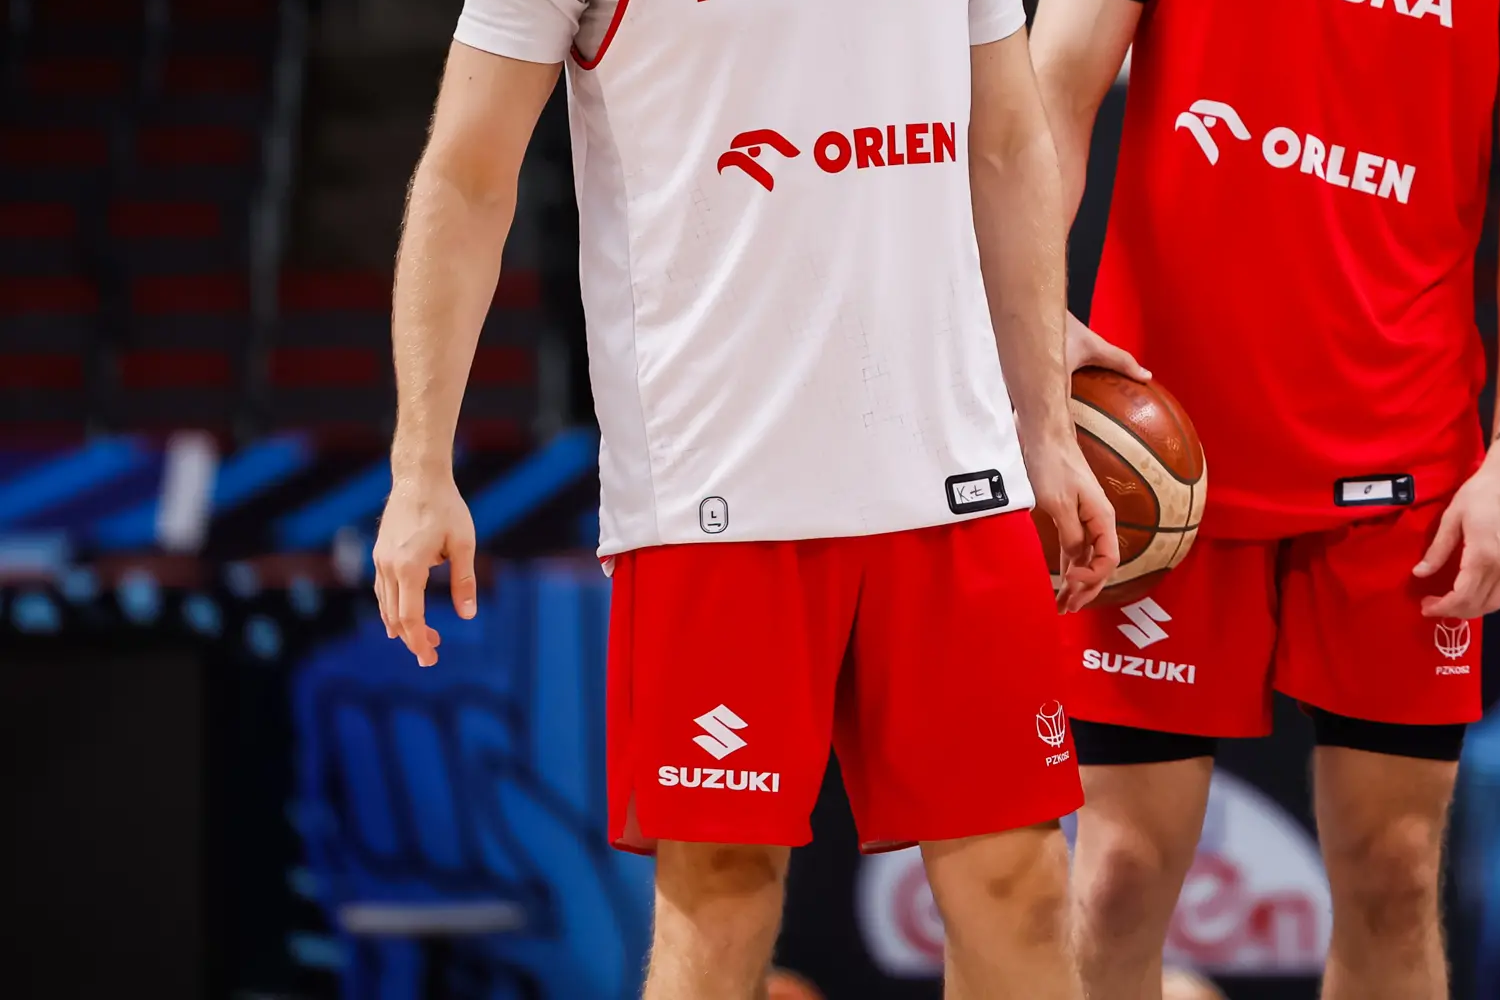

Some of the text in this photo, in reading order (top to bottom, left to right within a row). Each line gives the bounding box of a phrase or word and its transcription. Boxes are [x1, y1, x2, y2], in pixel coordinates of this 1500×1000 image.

[813, 122, 957, 174] ORLEN
[1262, 126, 1416, 205] ORLEN
[1082, 649, 1196, 684] SUZUKI
[658, 765, 780, 793] SUZUKI
